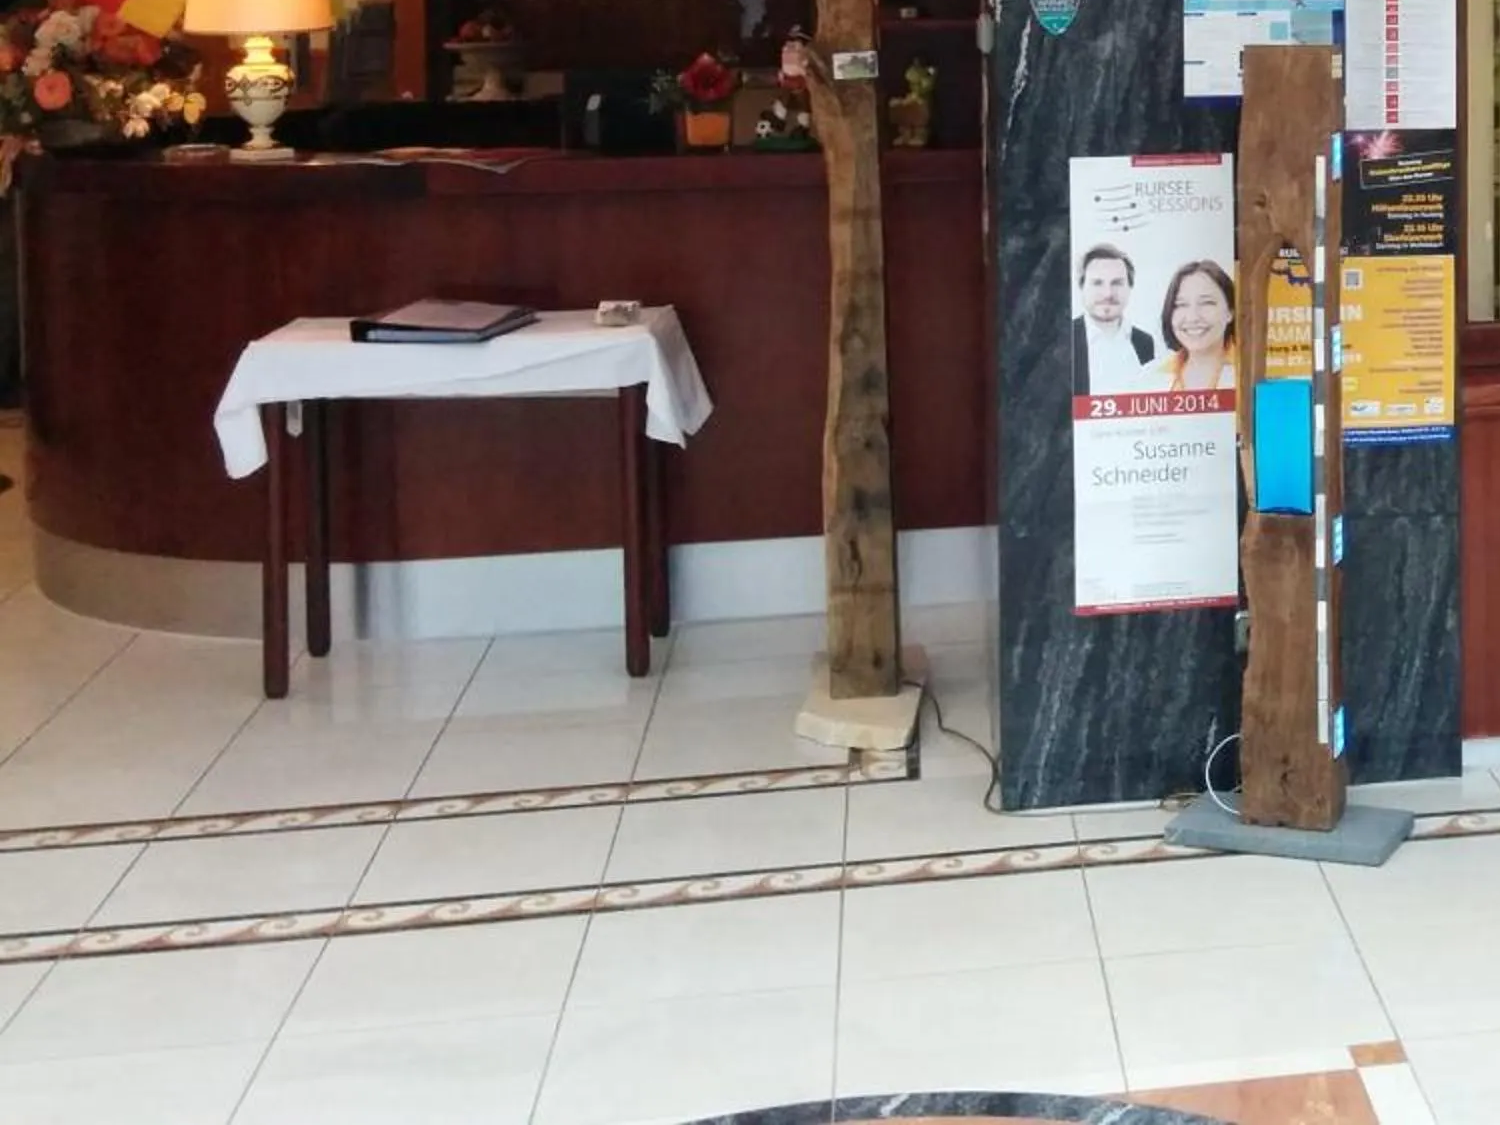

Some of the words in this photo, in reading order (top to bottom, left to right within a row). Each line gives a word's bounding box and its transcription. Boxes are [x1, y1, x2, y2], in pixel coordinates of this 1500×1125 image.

[1135, 180, 1194, 197] RURSEE
[1149, 195, 1224, 213] SESSIONS
[1090, 398, 1122, 417] 29.
[1128, 396, 1168, 415] JUNI
[1173, 394, 1220, 412] 2014
[1133, 439, 1216, 461] Susanne
[1091, 463, 1189, 487] Schneider
